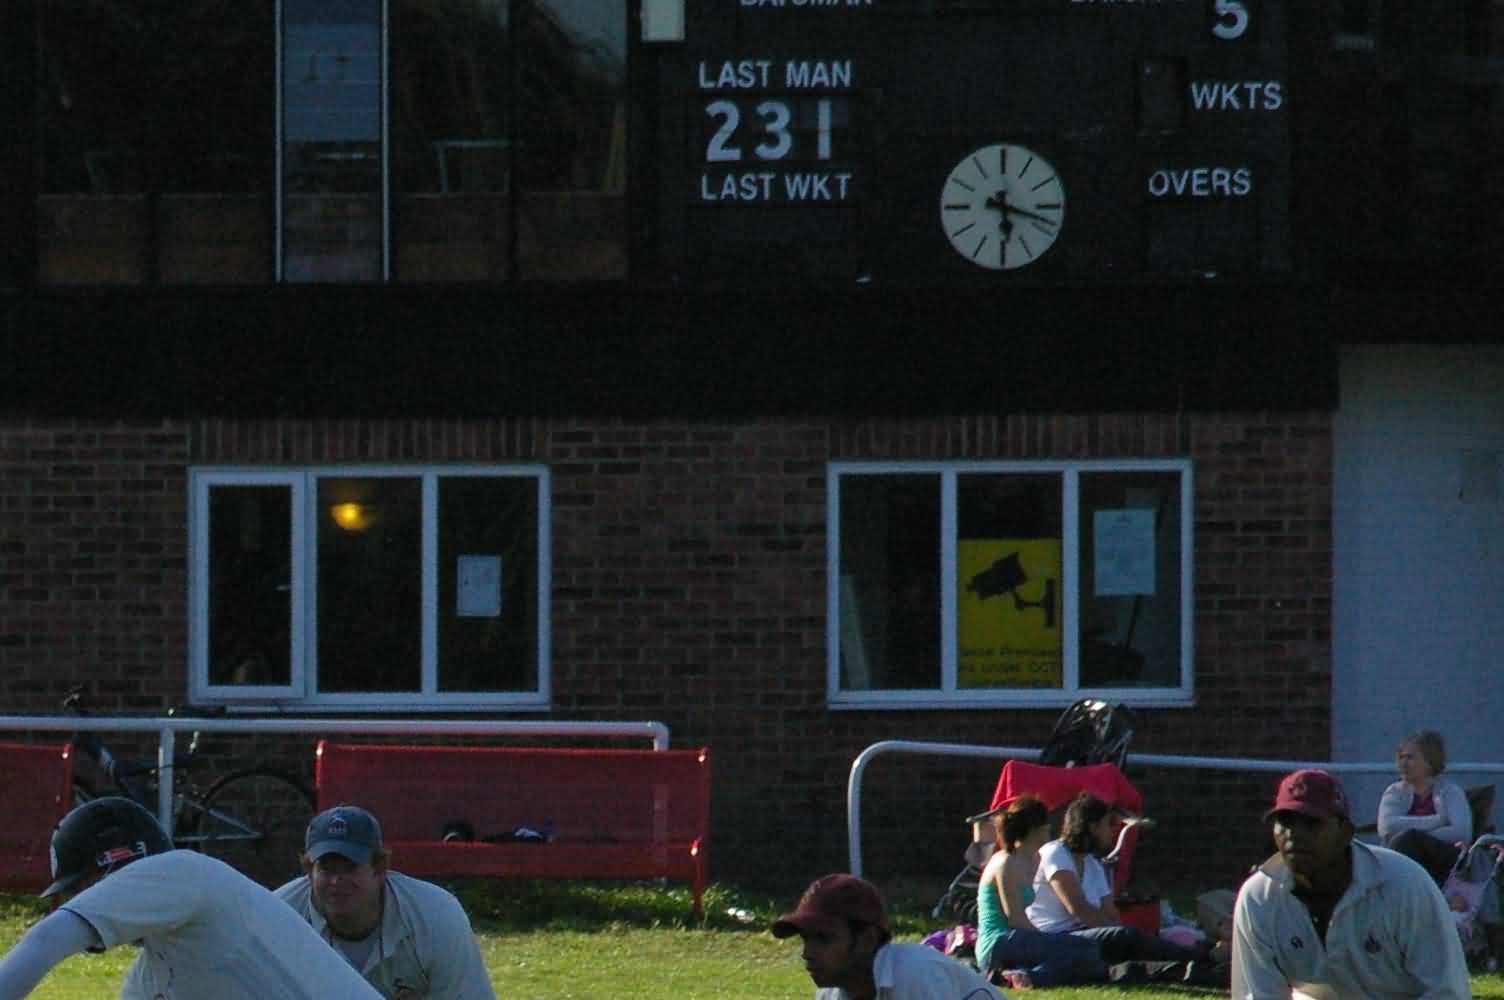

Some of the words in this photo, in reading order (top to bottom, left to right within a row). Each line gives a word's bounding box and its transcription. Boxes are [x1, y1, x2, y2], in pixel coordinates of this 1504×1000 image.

[1212, 0, 1249, 39] 5
[698, 60, 771, 88] LAST
[785, 60, 852, 88] MAN
[1191, 81, 1282, 110] WKTS
[701, 173, 776, 201] LAST
[784, 173, 853, 201] WKT
[1148, 167, 1252, 197] OVERS
